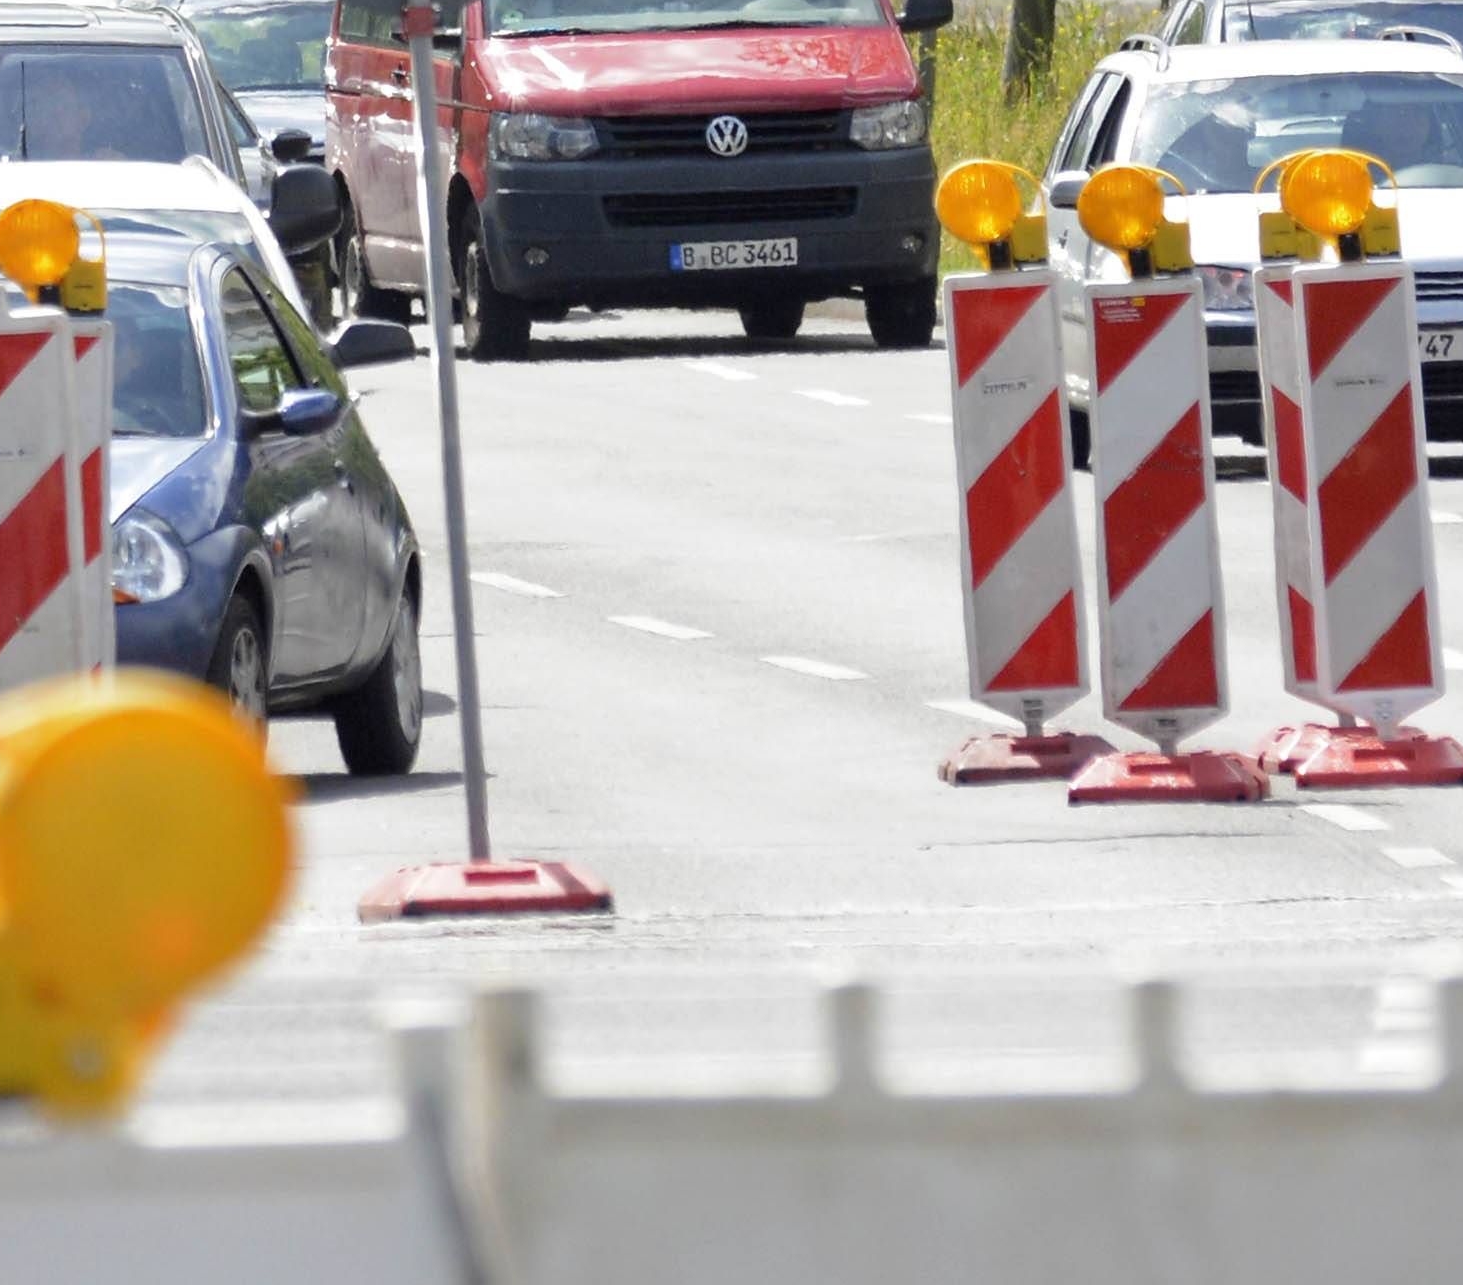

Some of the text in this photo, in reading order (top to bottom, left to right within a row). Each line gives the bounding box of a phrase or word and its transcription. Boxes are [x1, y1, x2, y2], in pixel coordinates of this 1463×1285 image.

[683, 242, 796, 267] B BC 3461
[1418, 333, 1454, 358] 47
